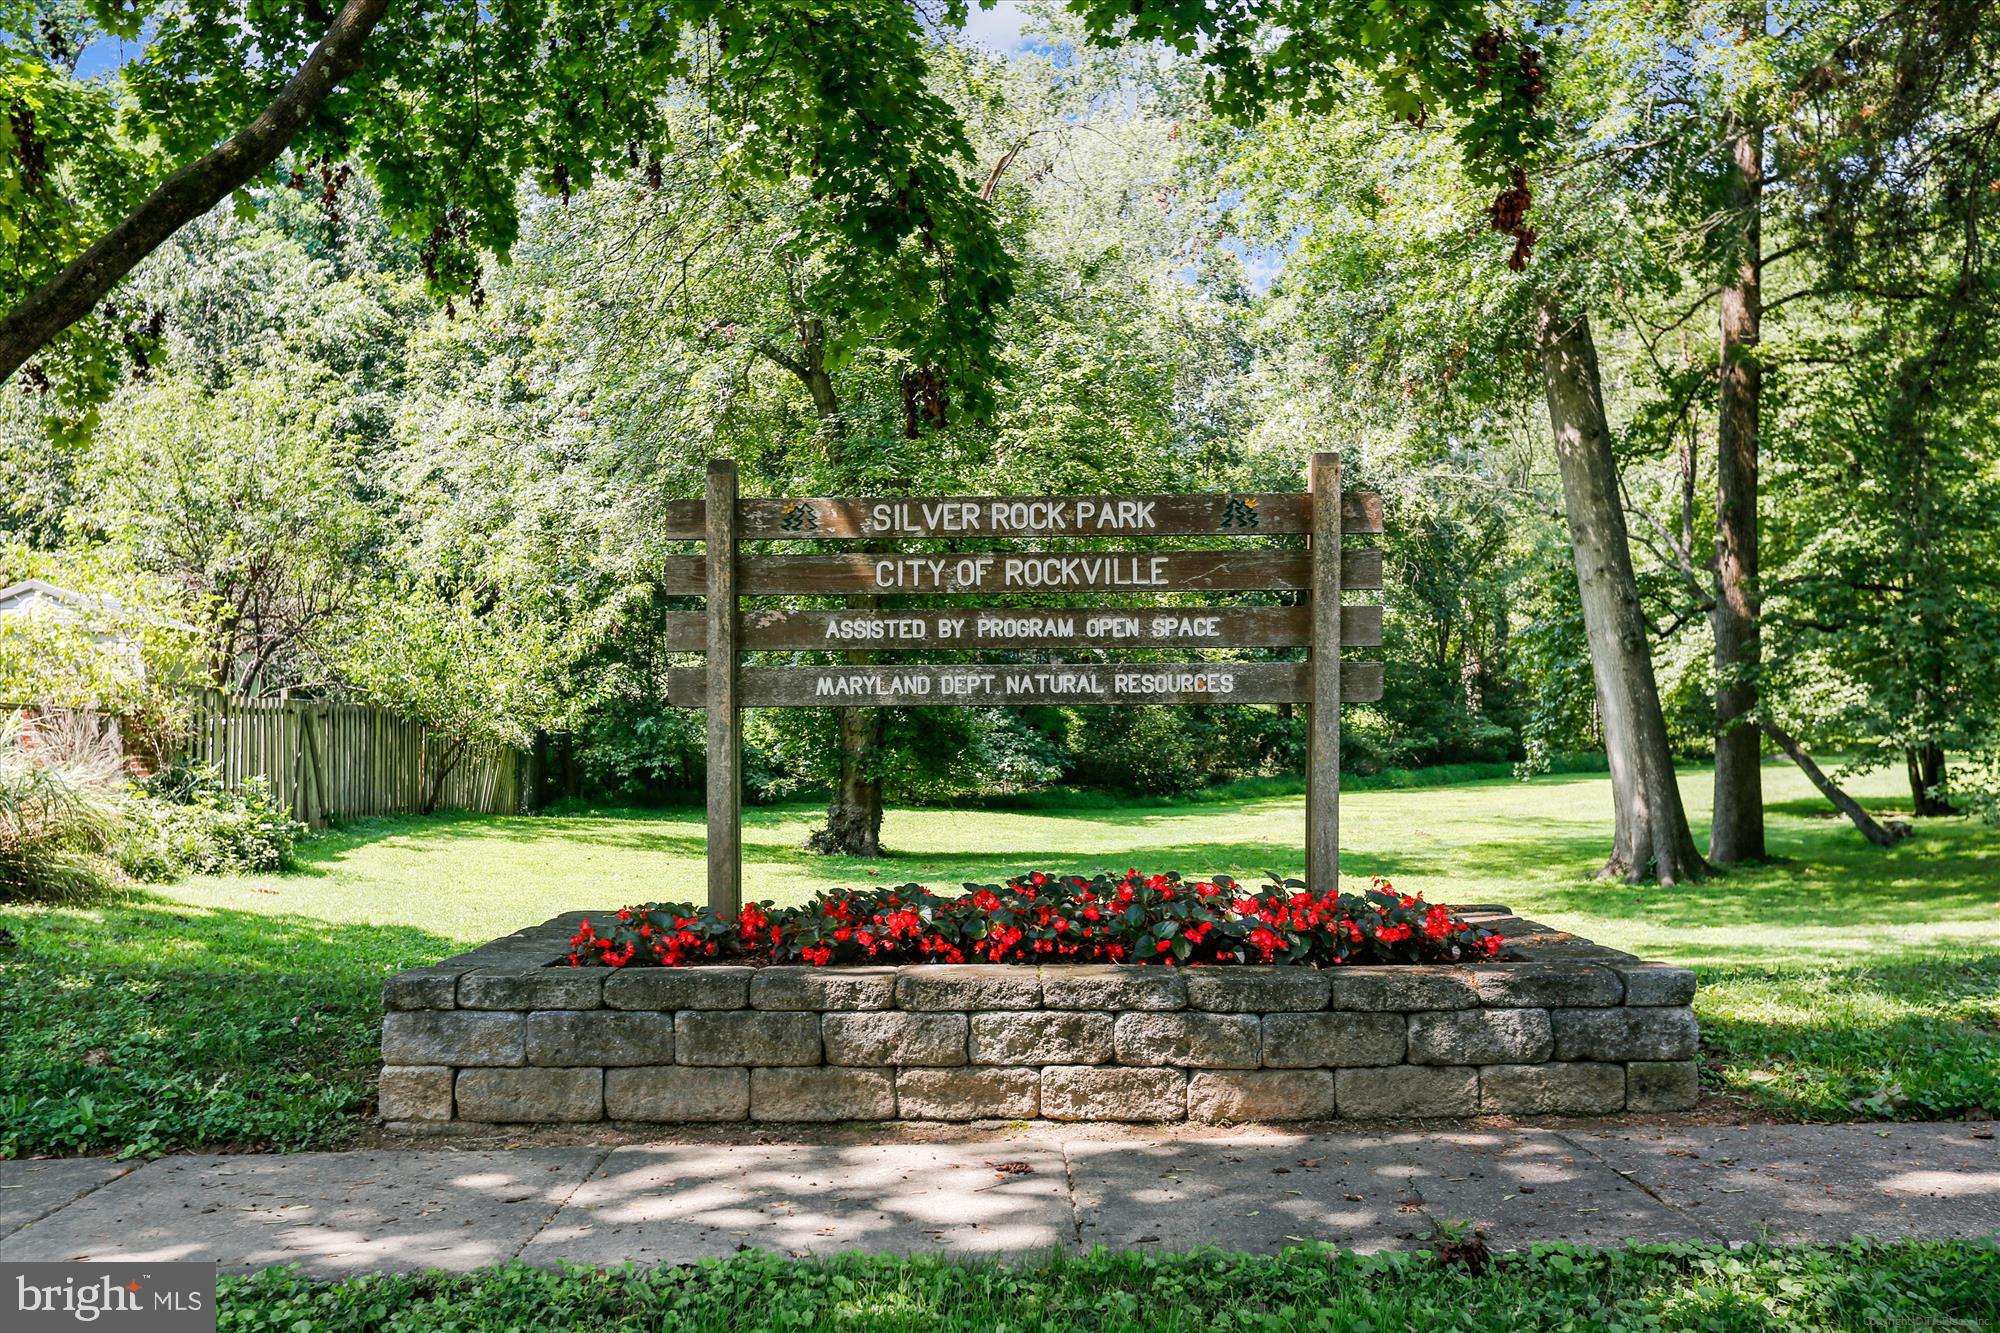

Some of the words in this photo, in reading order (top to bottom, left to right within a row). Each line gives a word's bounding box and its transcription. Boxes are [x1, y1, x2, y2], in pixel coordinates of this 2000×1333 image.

[873, 502, 980, 531] SILVER
[991, 501, 1066, 529] ROCK
[1077, 501, 1156, 528] PARK
[875, 559, 946, 587] CITY
[956, 558, 994, 586] OF
[1005, 557, 1169, 586] ROCKVILLE
[825, 619, 926, 639] ASSISTED
[938, 618, 965, 638] BY
[977, 617, 1074, 638] PROGRAM
[1086, 617, 1139, 638] OPEN
[1151, 616, 1221, 638] SPACE
[815, 675, 930, 696] MARYLAND
[1006, 674, 1104, 694] NATURAL
[1115, 673, 1234, 694] RESOURCES
